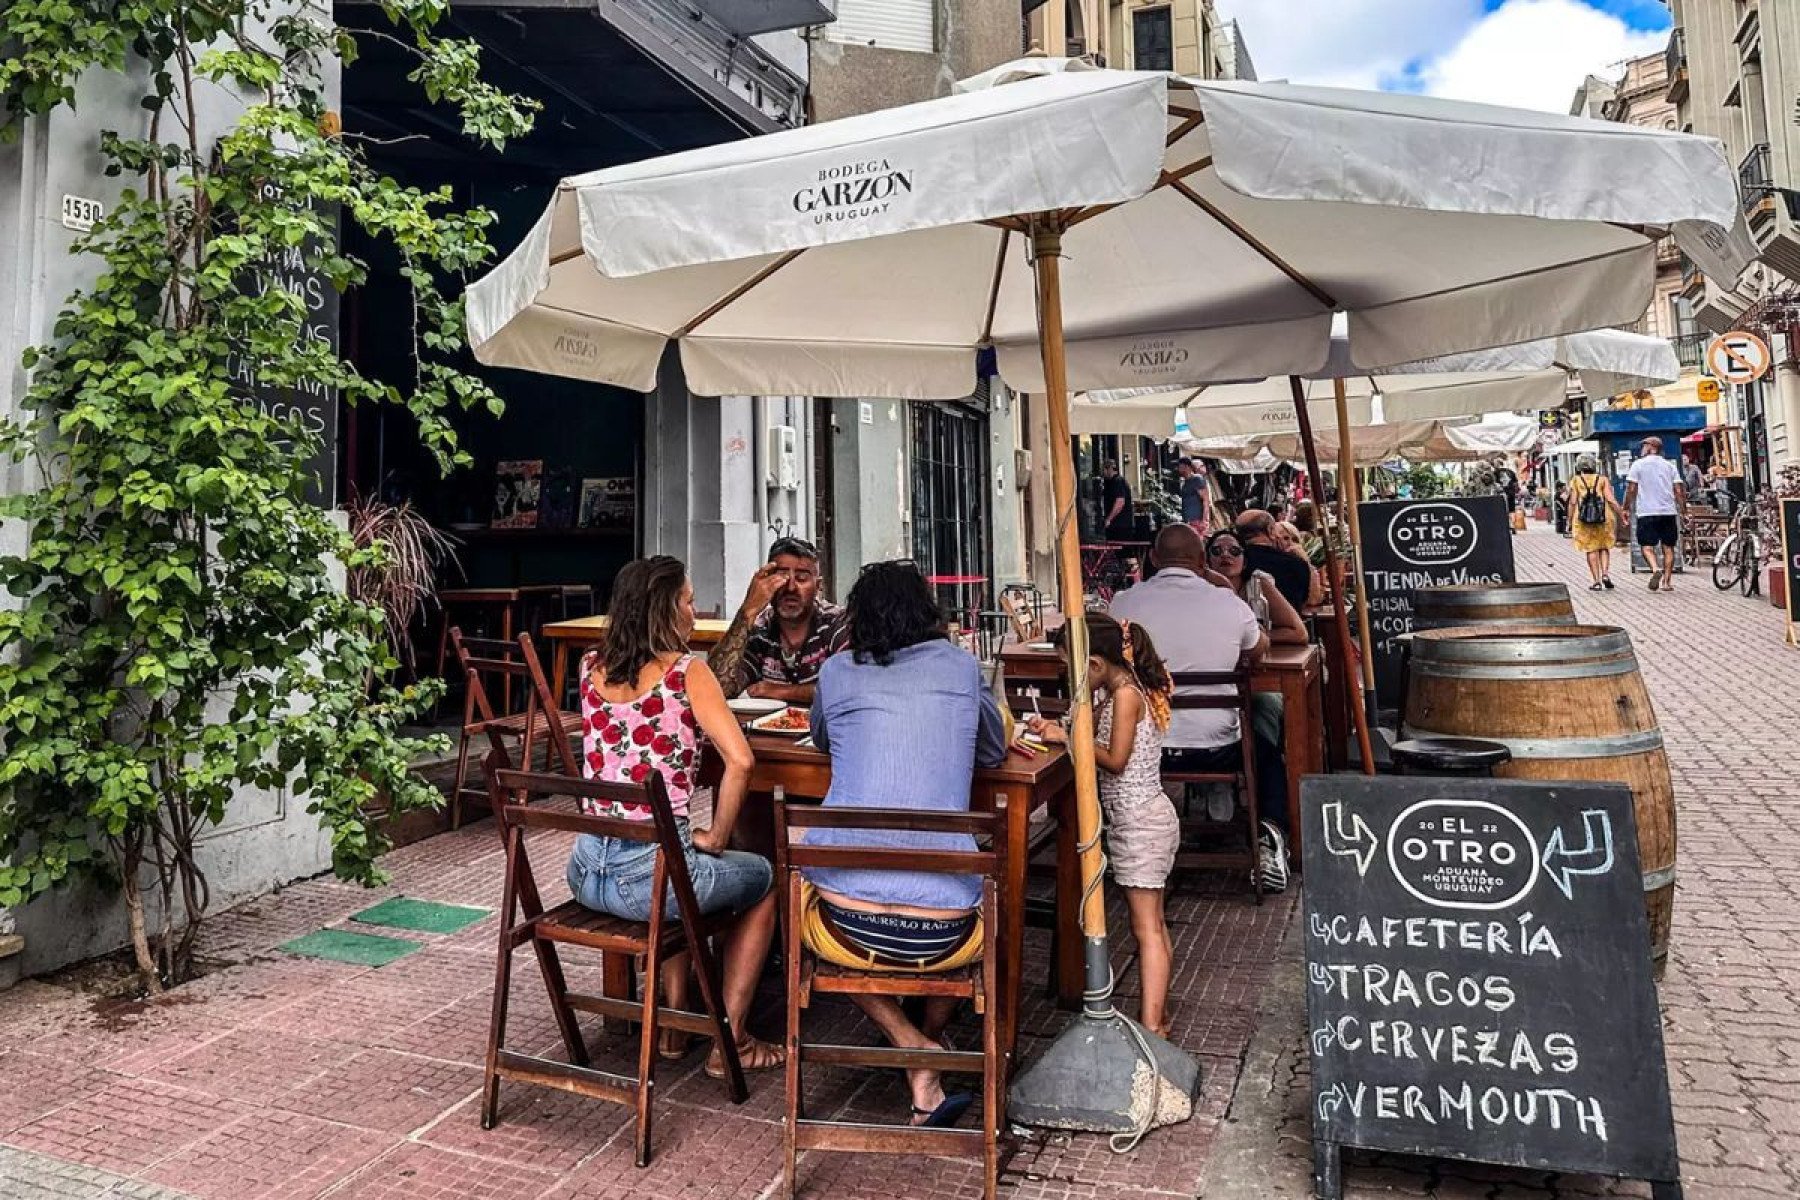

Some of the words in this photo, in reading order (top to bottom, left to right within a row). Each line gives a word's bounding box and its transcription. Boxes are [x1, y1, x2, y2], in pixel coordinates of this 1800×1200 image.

[818, 159, 890, 181] BODEGA
[793, 168, 914, 213] GARZÓN
[66, 199, 99, 222] 1530
[814, 203, 889, 225] URUGUAY
[1726, 343, 1749, 372] E
[1421, 513, 1439, 523] EL
[1397, 525, 1464, 541] OTRO
[1365, 571, 1433, 591] TIENDA
[1419, 821, 1435, 830] 20
[1442, 817, 1474, 834] EL
[1482, 824, 1498, 833] 22
[1403, 838, 1516, 865] OTRO
[1422, 874, 1504, 886] MONTEVIDEO
[1437, 866, 1488, 877] ADUANA
[1434, 883, 1493, 894] URUGUAY
[1331, 912, 1562, 959] CAFETERÍA
[1329, 963, 1515, 1011] TRAGOS
[1336, 1016, 1579, 1075] CERVEZAS
[1344, 1080, 1609, 1142] VERMOUTH
